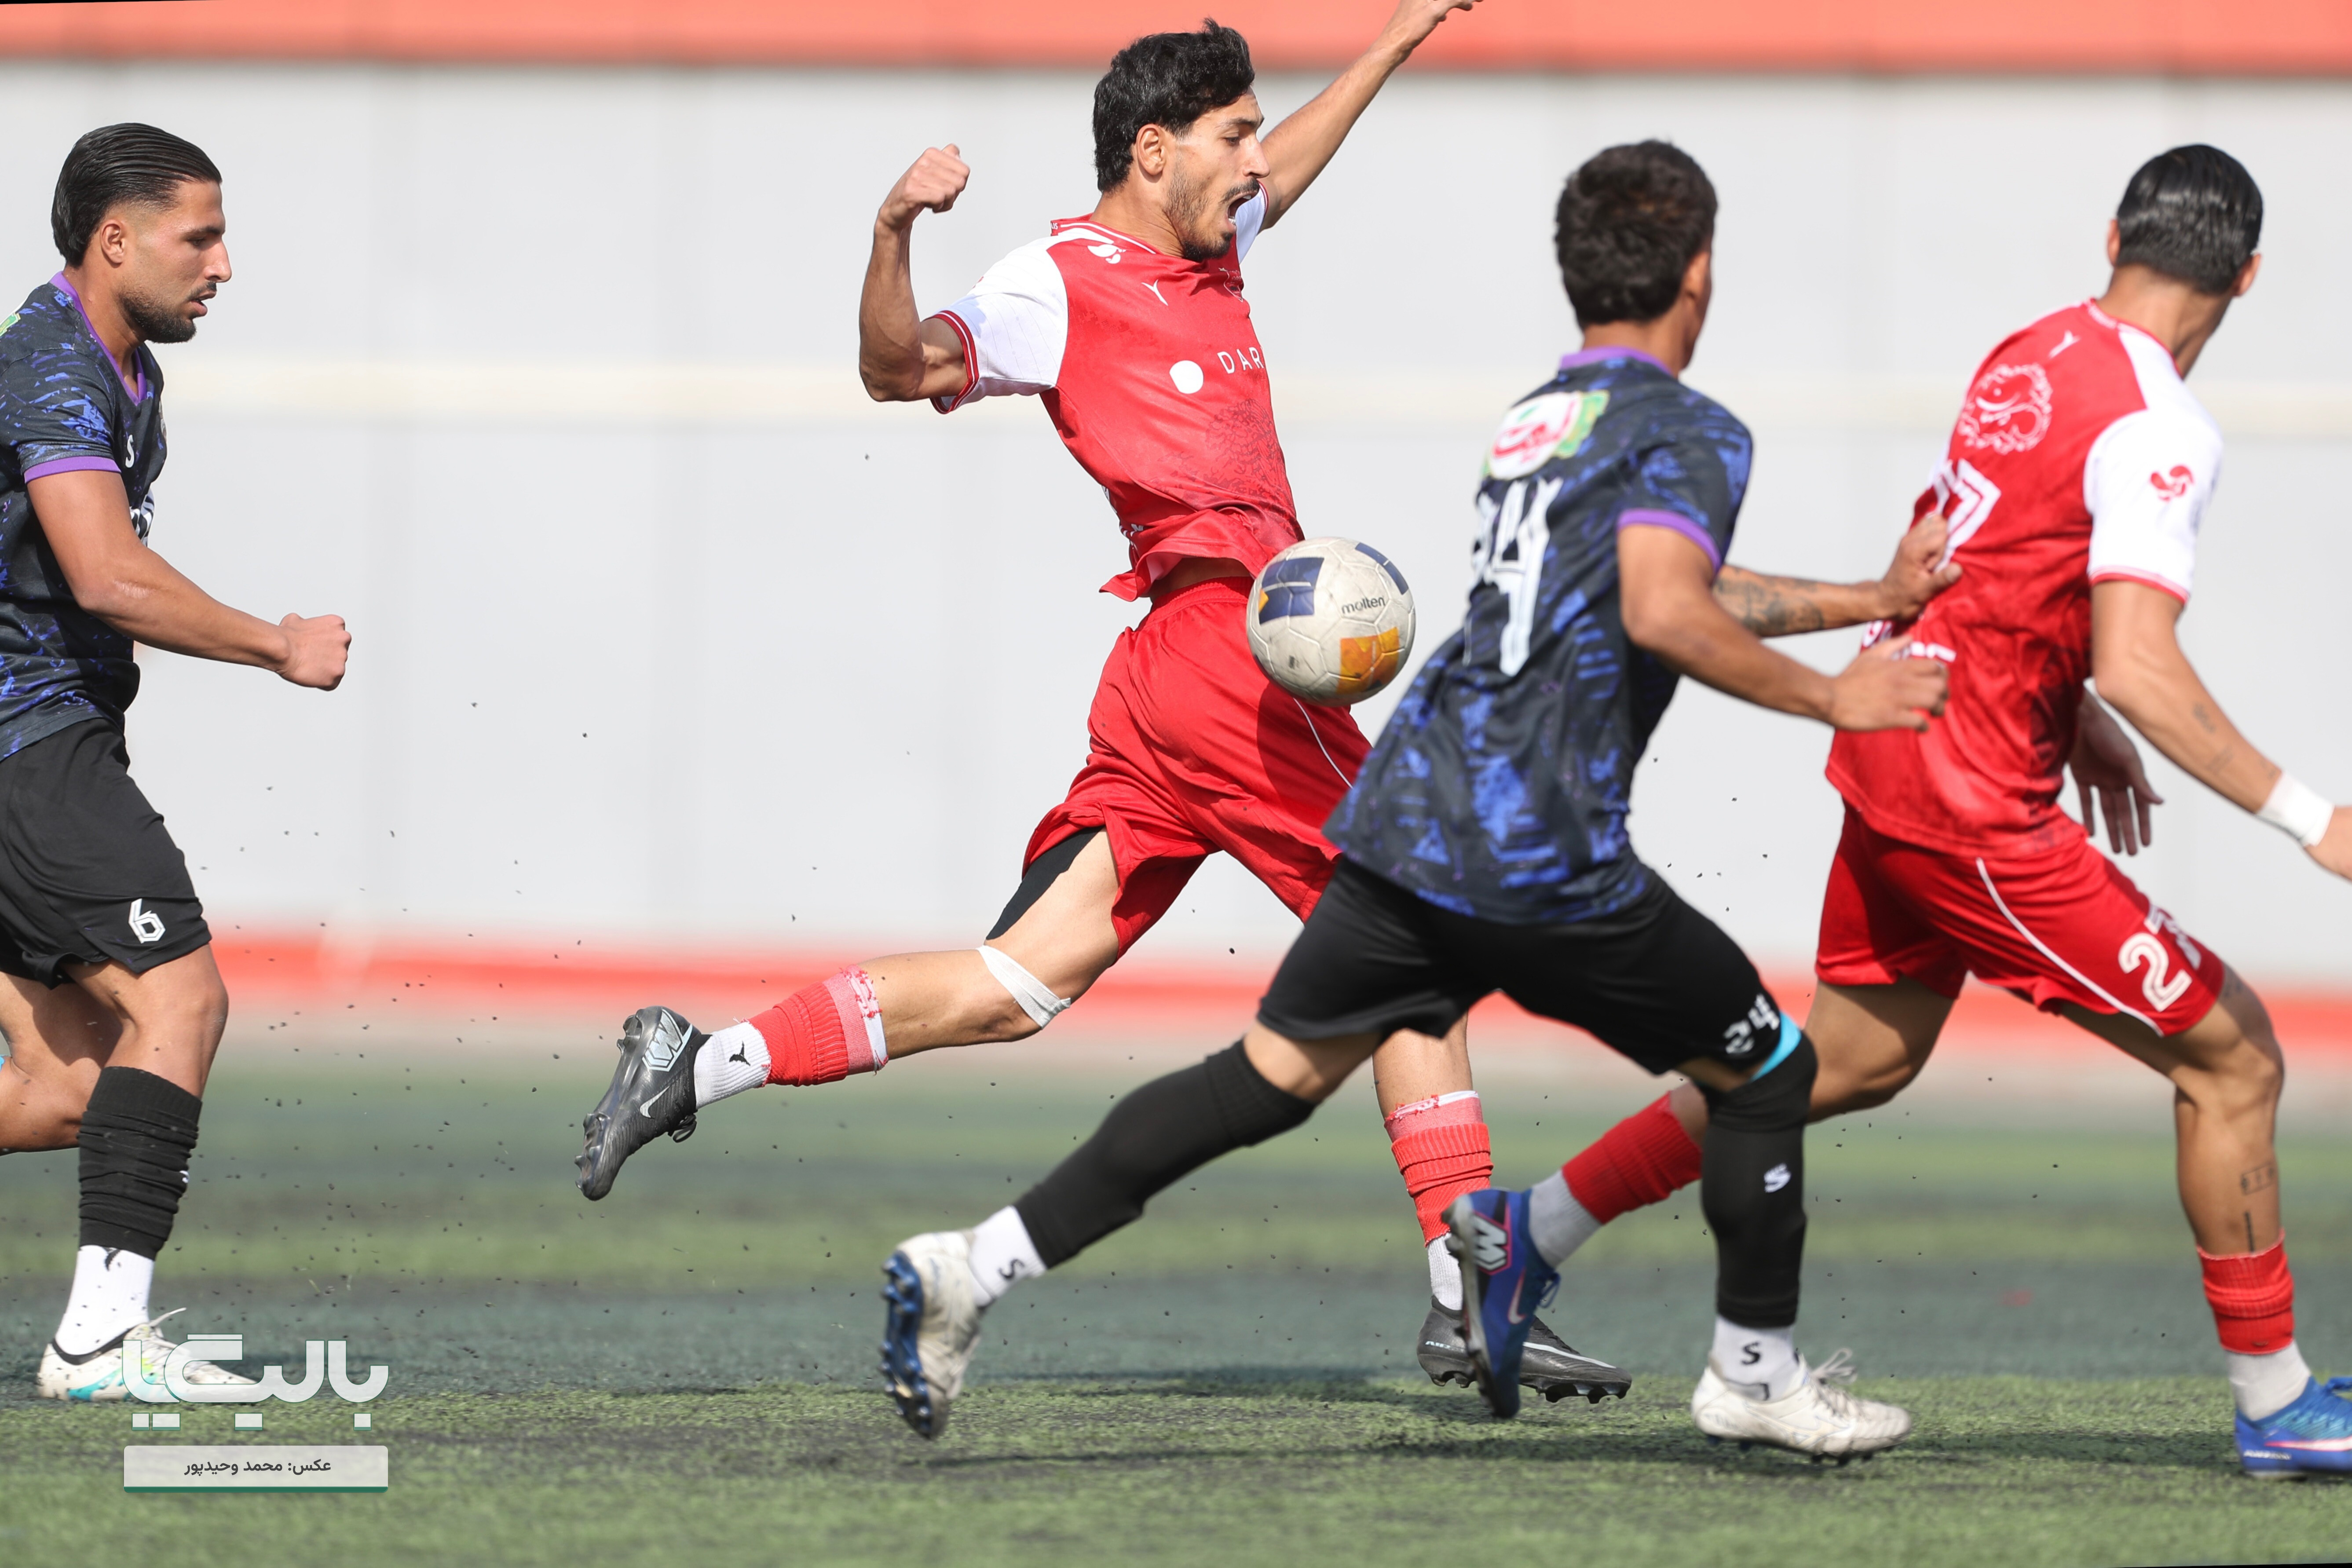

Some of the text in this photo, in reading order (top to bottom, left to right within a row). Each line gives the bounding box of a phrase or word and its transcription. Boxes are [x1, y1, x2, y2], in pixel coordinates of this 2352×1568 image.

[1217, 346, 1265, 374] DAR
[1341, 596, 1386, 614] molten
[128, 898, 166, 944] 6
[1723, 992, 1780, 1054] 24
